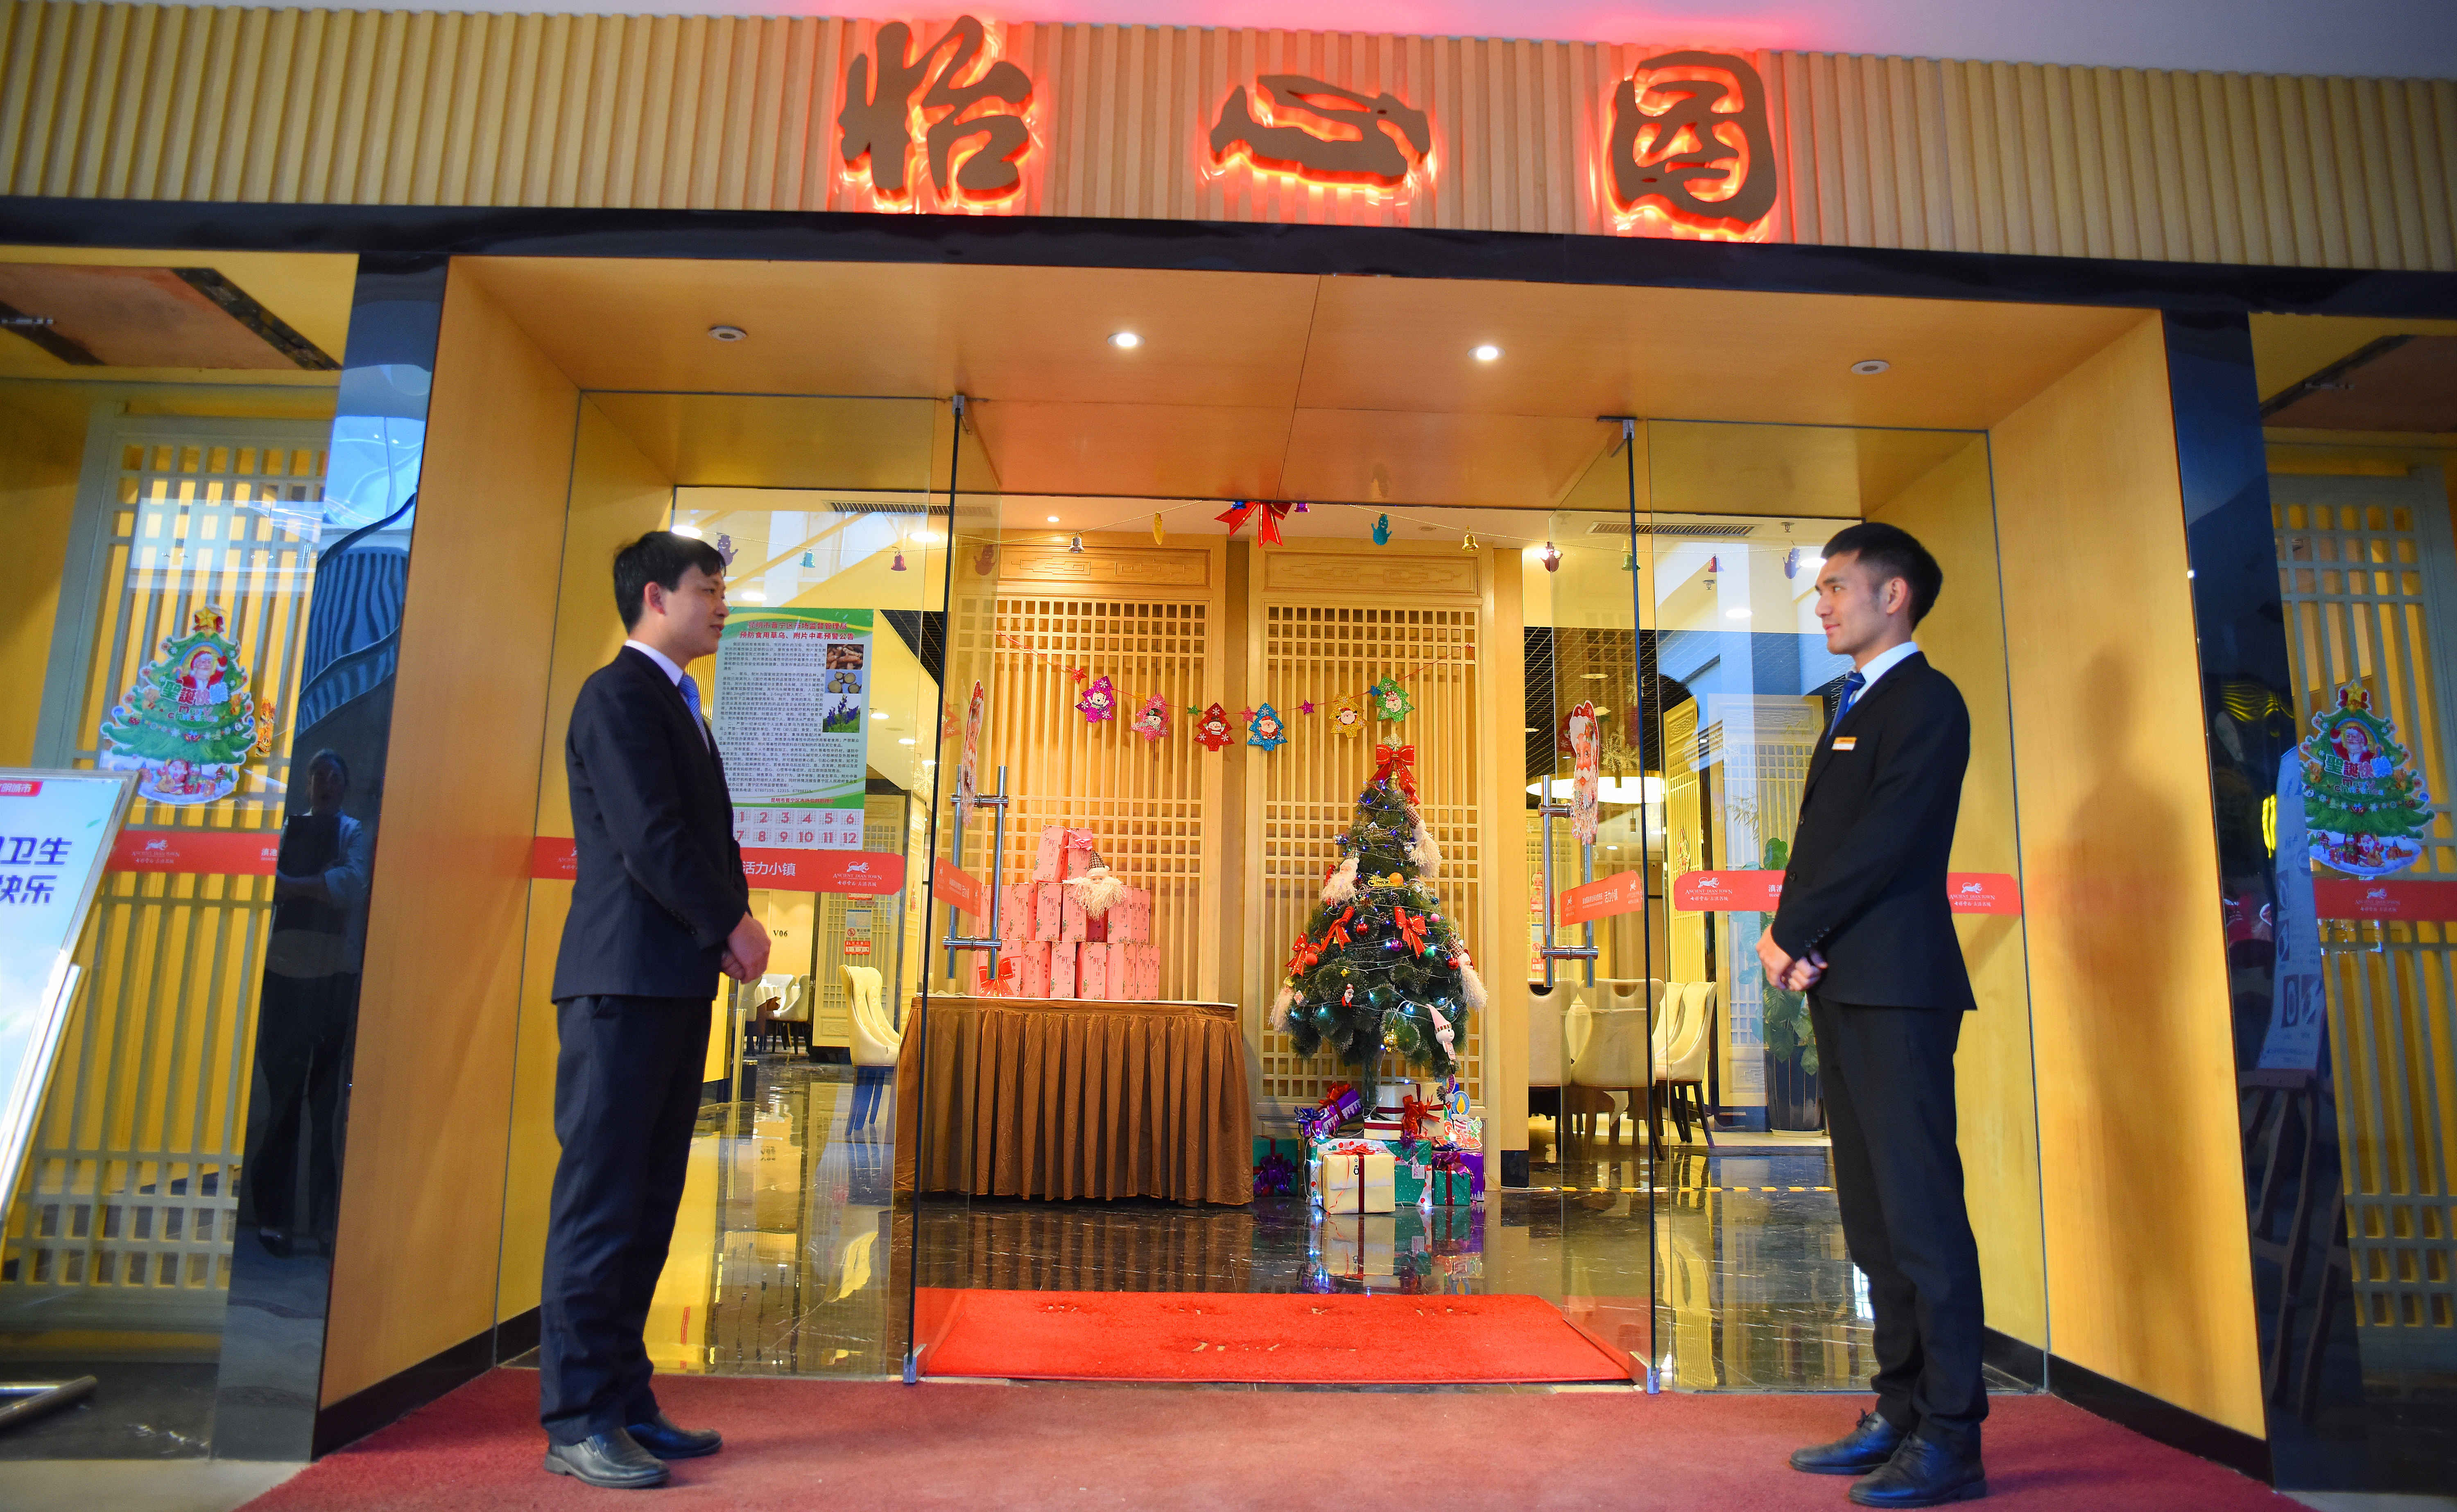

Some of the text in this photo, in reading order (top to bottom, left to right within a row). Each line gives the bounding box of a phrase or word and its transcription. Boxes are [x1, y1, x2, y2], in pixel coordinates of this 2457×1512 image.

[740, 812, 854, 824] 1 2 3 4 5 6
[737, 831, 857, 843] 7 8 9 10 11 12
[0, 836, 72, 866] 卫生
[743, 861, 796, 877] 活力小镇
